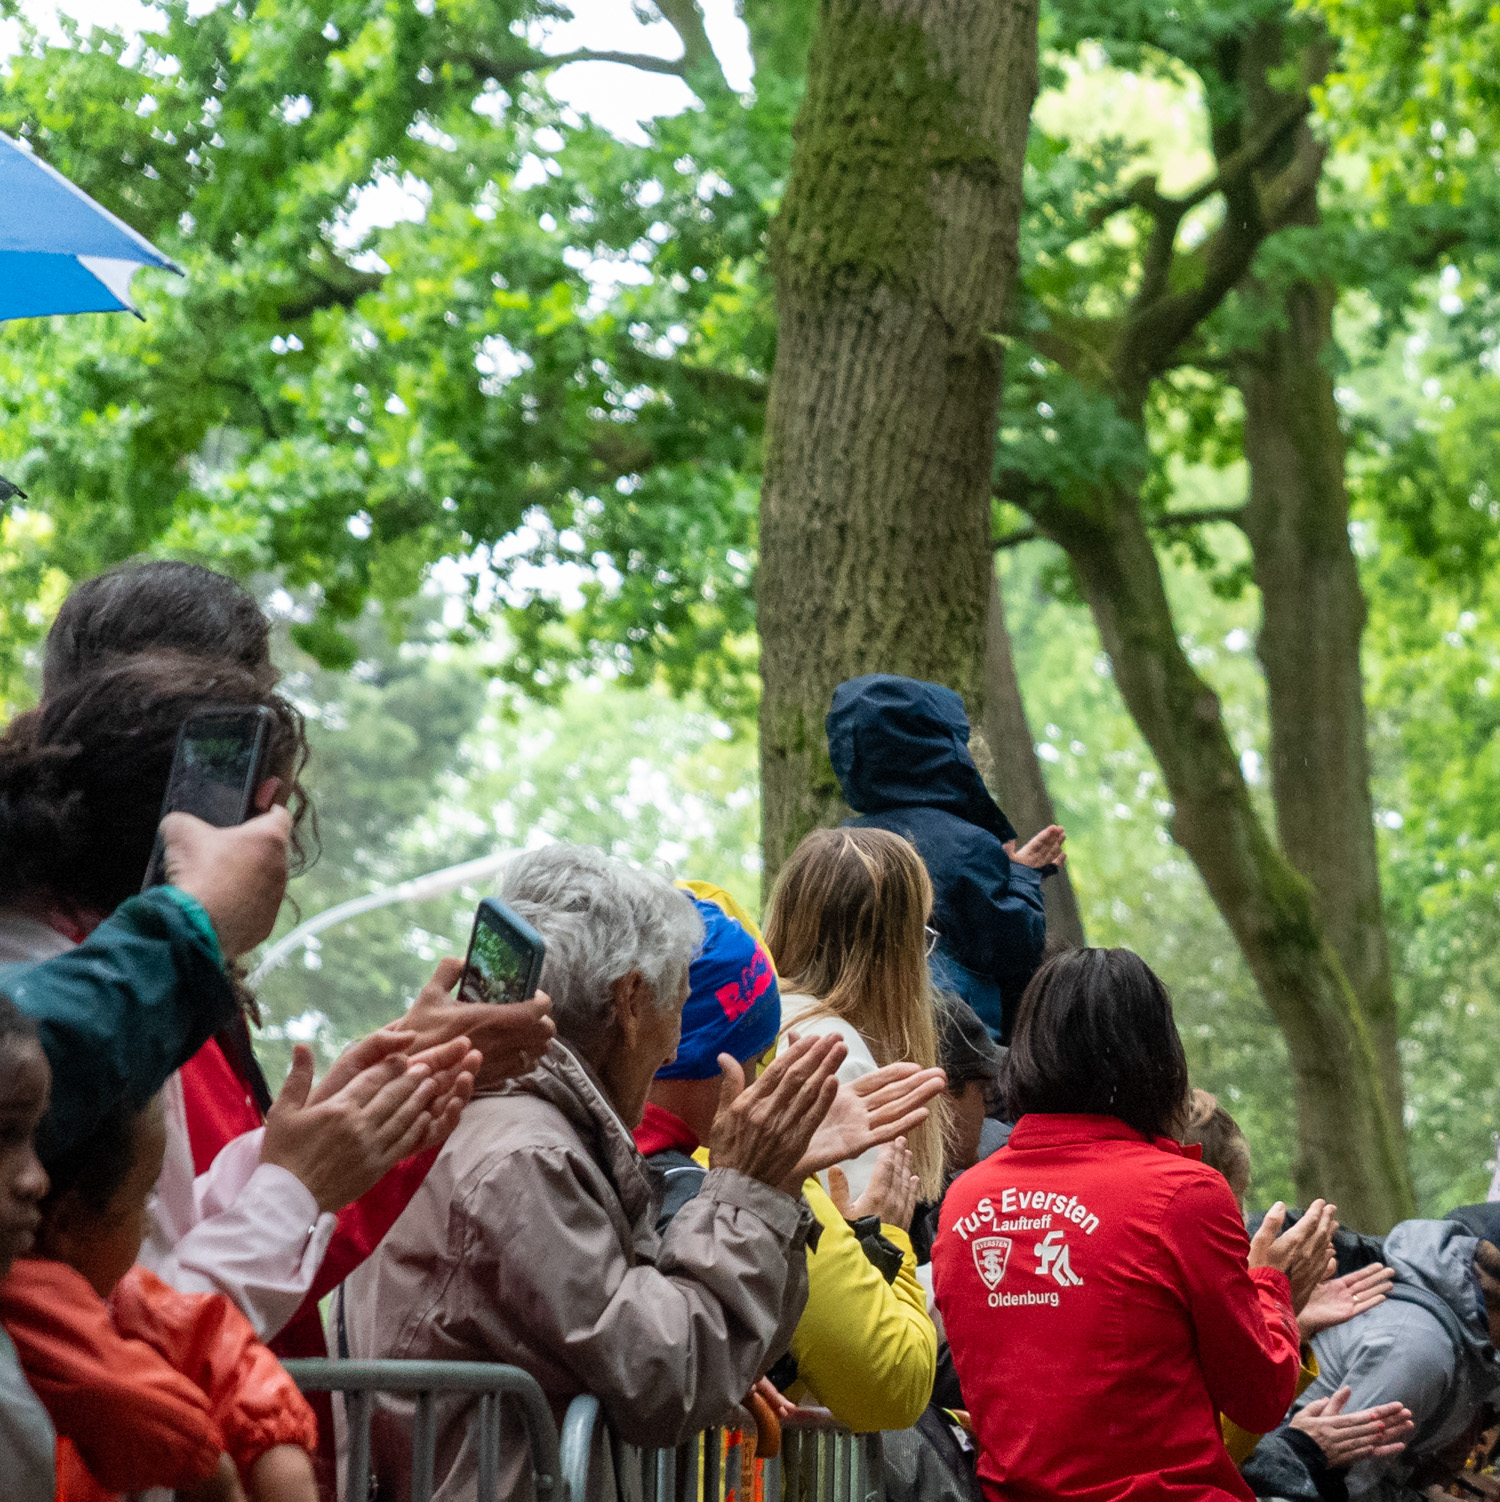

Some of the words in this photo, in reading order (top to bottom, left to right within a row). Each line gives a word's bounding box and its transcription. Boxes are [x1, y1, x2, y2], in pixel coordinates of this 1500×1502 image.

[952, 1197, 995, 1241] TuS
[1001, 1187, 1100, 1235] Eversten
[992, 1214, 1052, 1232] Lauftreff
[987, 1290, 1059, 1307] Oldenburg
